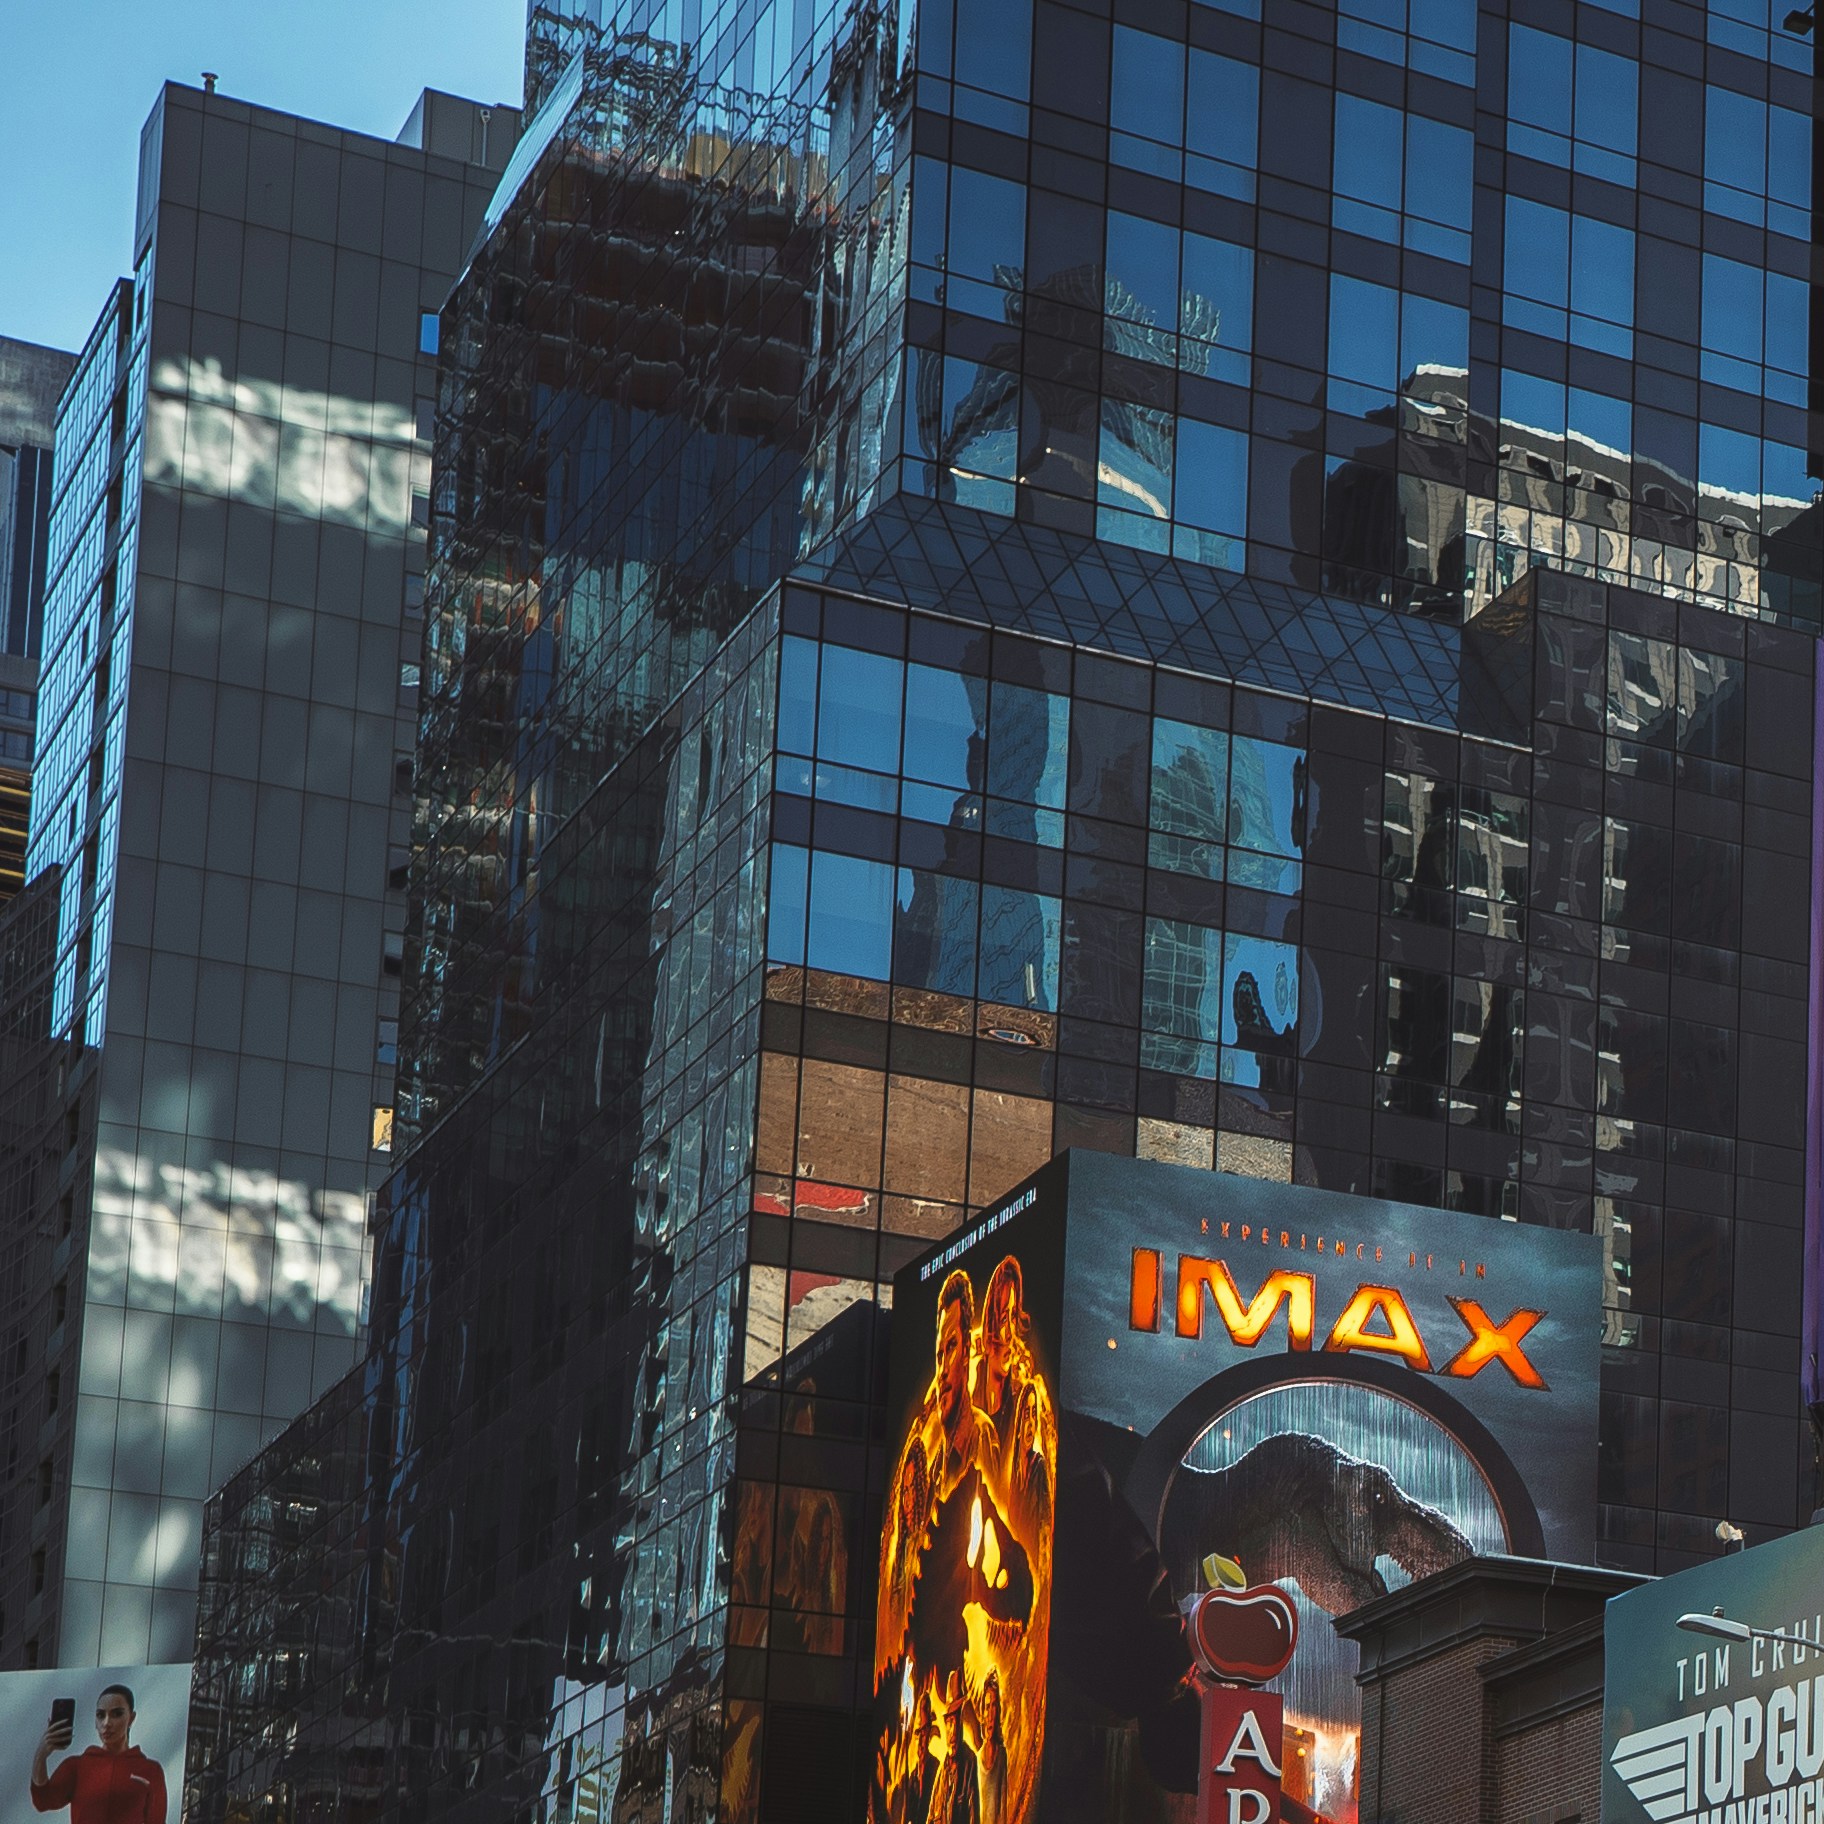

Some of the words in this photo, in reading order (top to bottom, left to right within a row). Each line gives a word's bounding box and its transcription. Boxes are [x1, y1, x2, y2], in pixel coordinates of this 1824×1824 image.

[1200, 1217, 1383, 1262] EXPERIENCE
[1460, 1260, 1487, 1279] IN
[1129, 1246, 1551, 1393] IMAX
[1677, 1644, 1730, 1702] TOM
[1684, 1694, 1763, 1812] TOP
